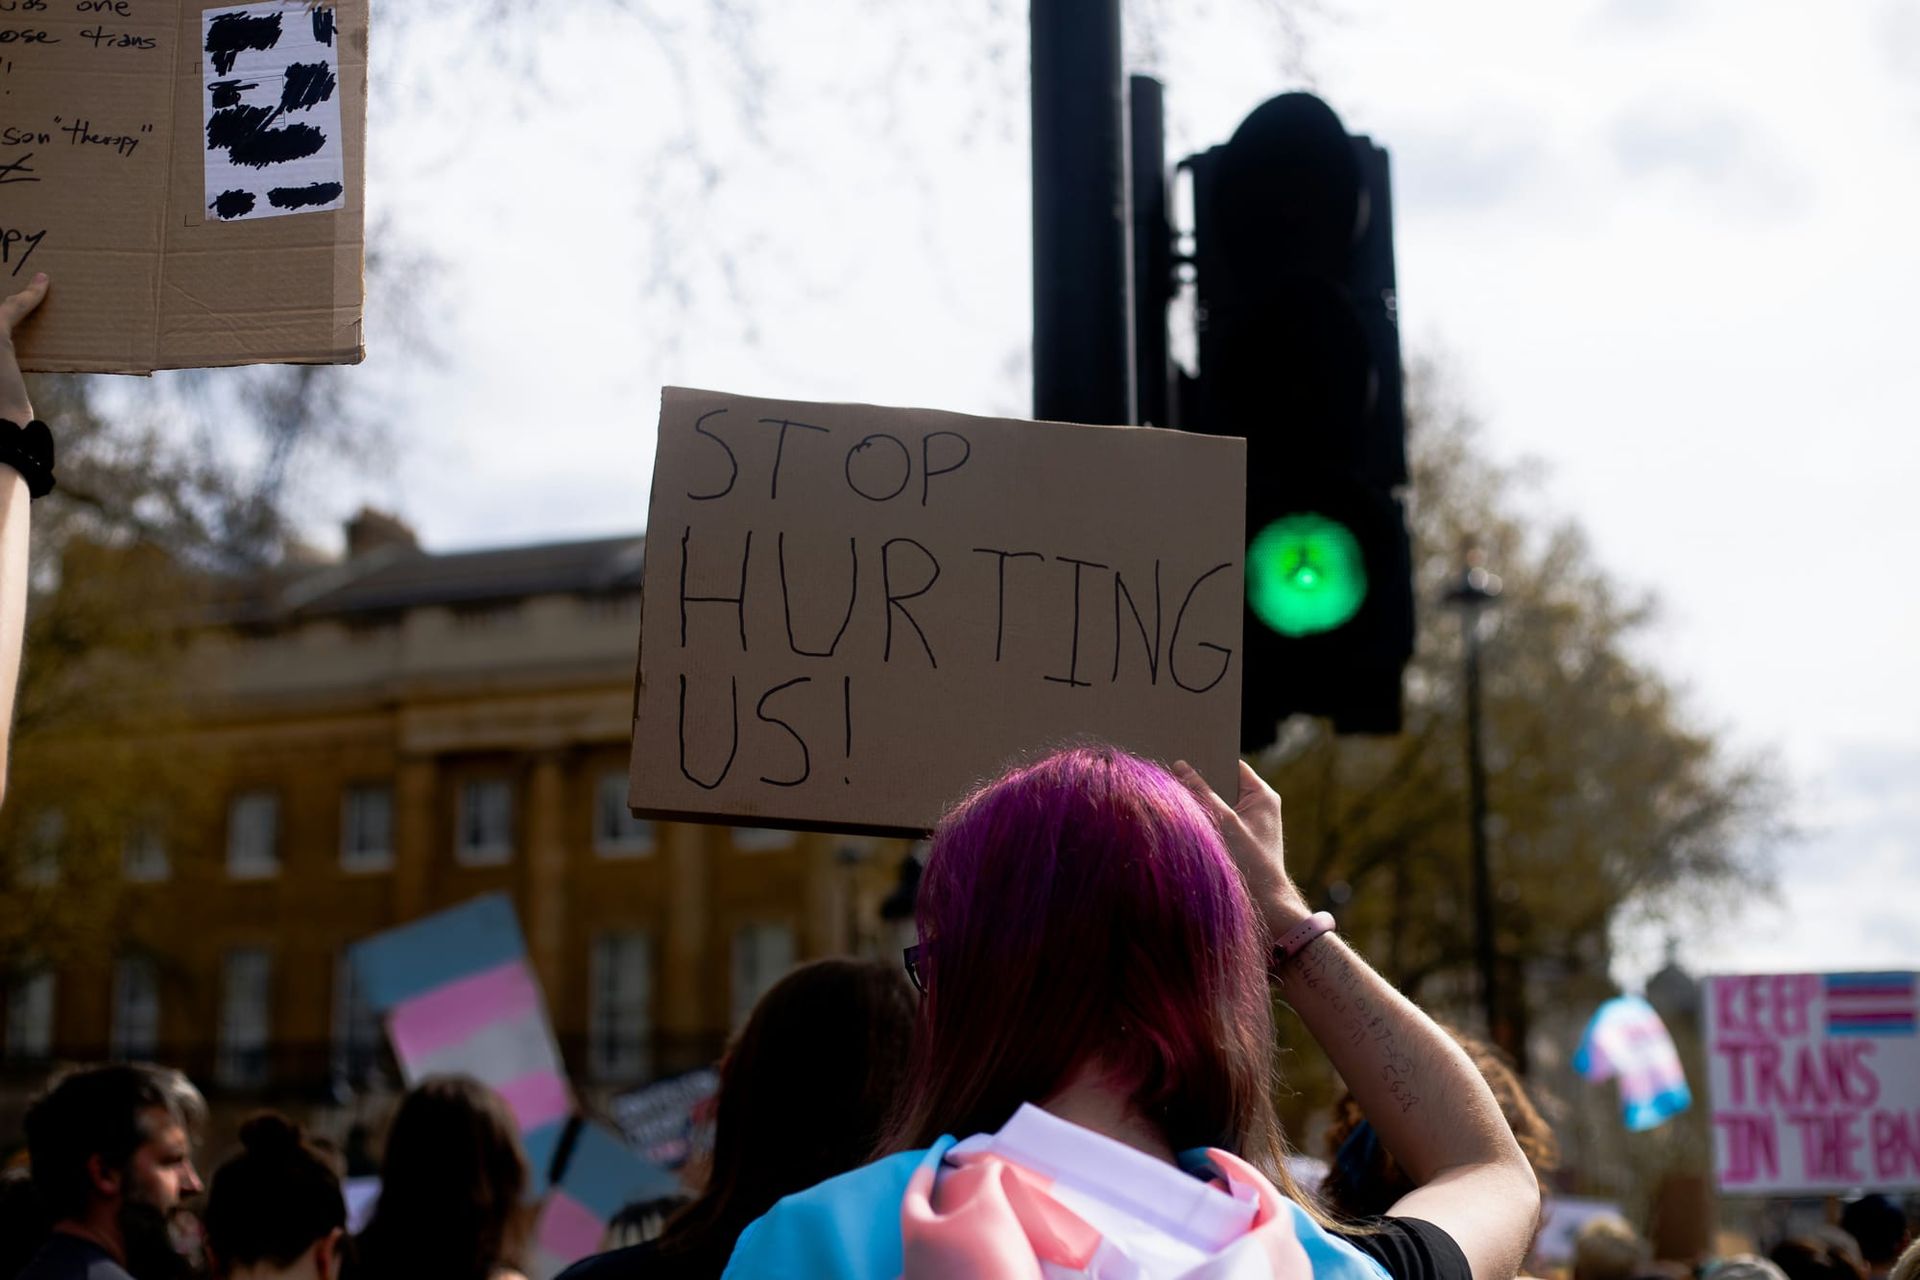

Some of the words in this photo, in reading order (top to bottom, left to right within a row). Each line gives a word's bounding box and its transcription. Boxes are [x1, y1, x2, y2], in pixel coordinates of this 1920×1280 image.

[76, 0, 131, 17] one
[80, 25, 156, 49] trans
[0, 229, 47, 276] py
[687, 408, 970, 506] STOP
[680, 525, 1232, 693] HURTING
[679, 673, 851, 790] US!
[1714, 976, 1820, 1037] KEEP
[1715, 1040, 1880, 1108] TRANS
[1713, 1112, 1782, 1184] IN
[1787, 1110, 1864, 1184] THE
